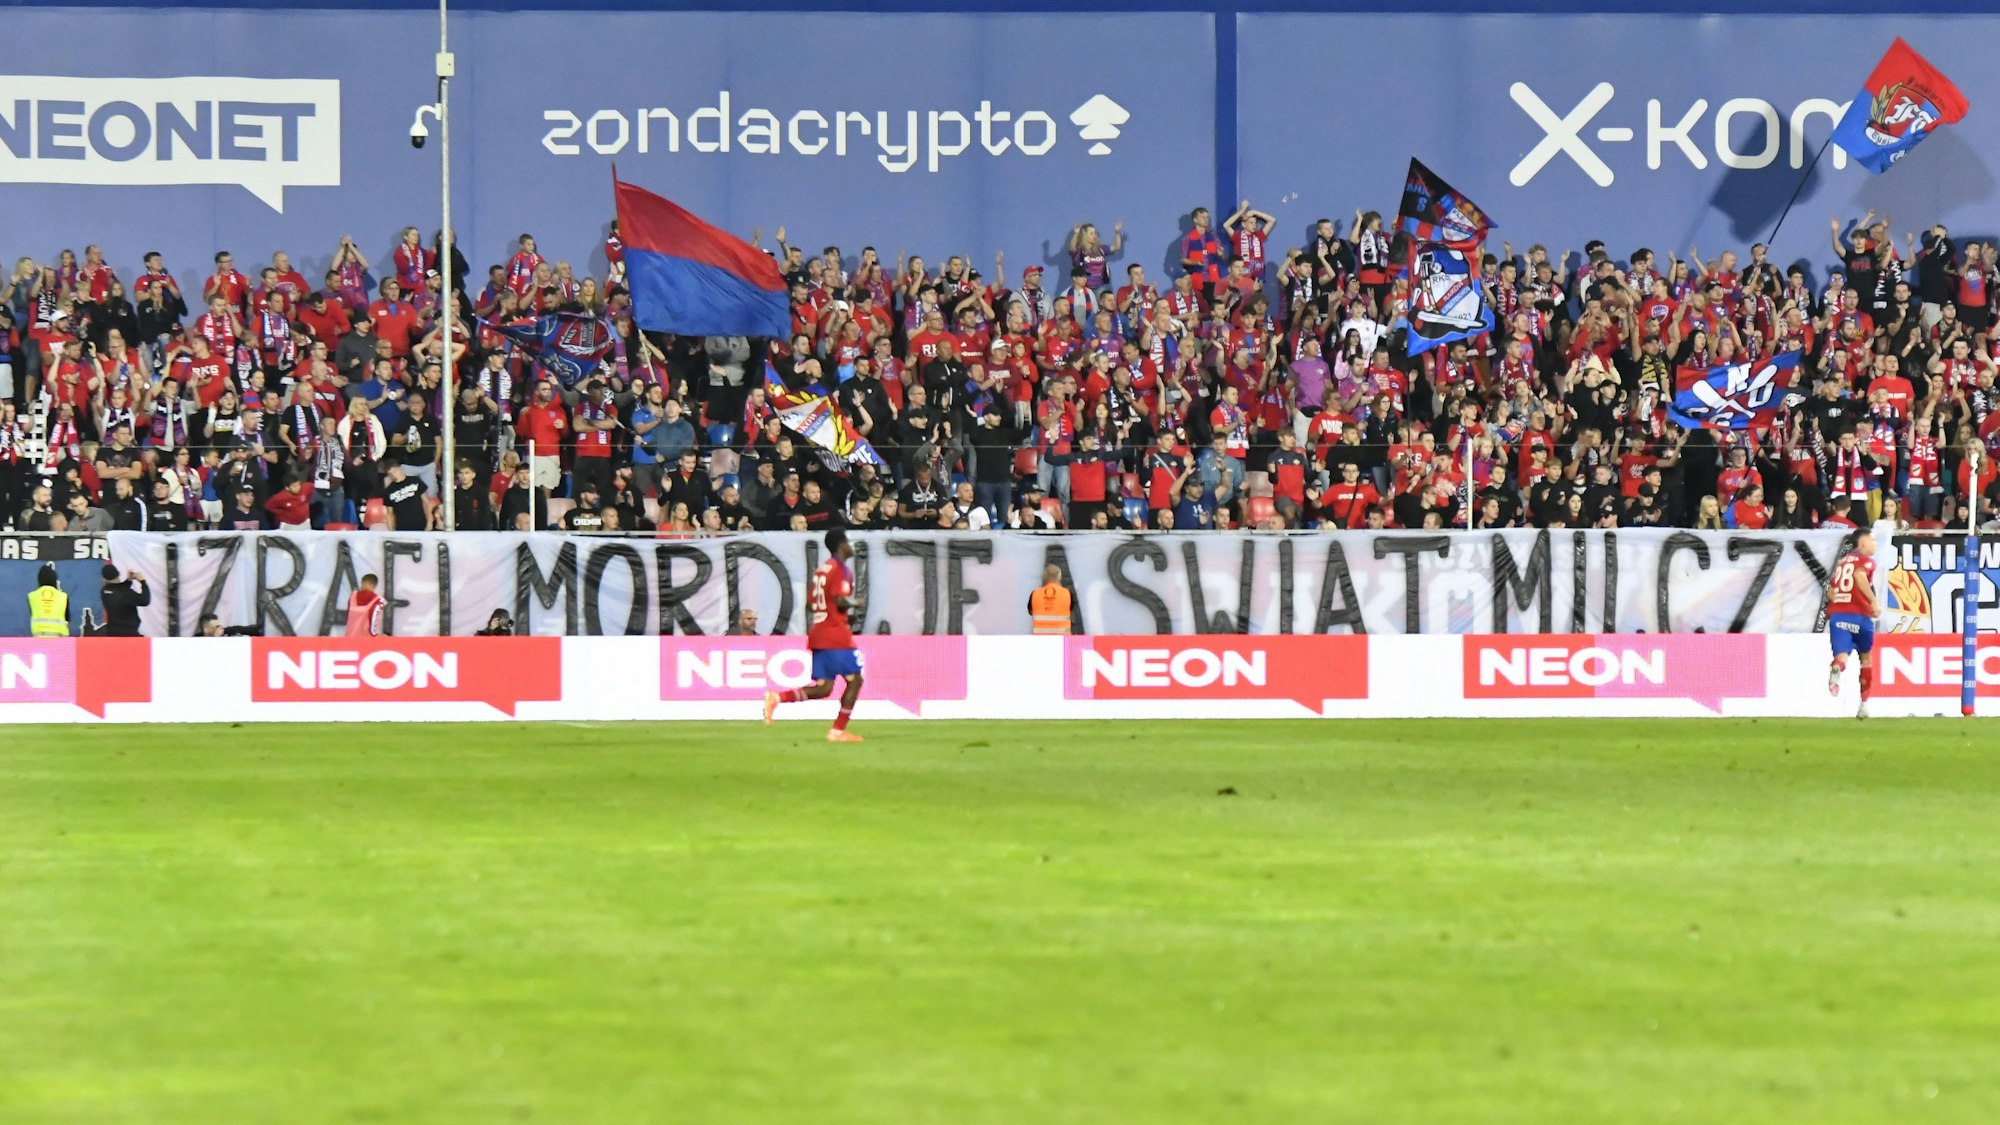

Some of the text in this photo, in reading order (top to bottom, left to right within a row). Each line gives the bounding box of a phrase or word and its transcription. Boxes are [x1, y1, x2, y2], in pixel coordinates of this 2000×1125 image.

[541, 91, 1057, 172] zondacrypto
[0, 539, 39, 560] AS
[268, 650, 458, 689] NEON
[677, 650, 812, 688] NEO
[1082, 649, 1267, 687] NEON
[1480, 648, 1665, 686] NEON
